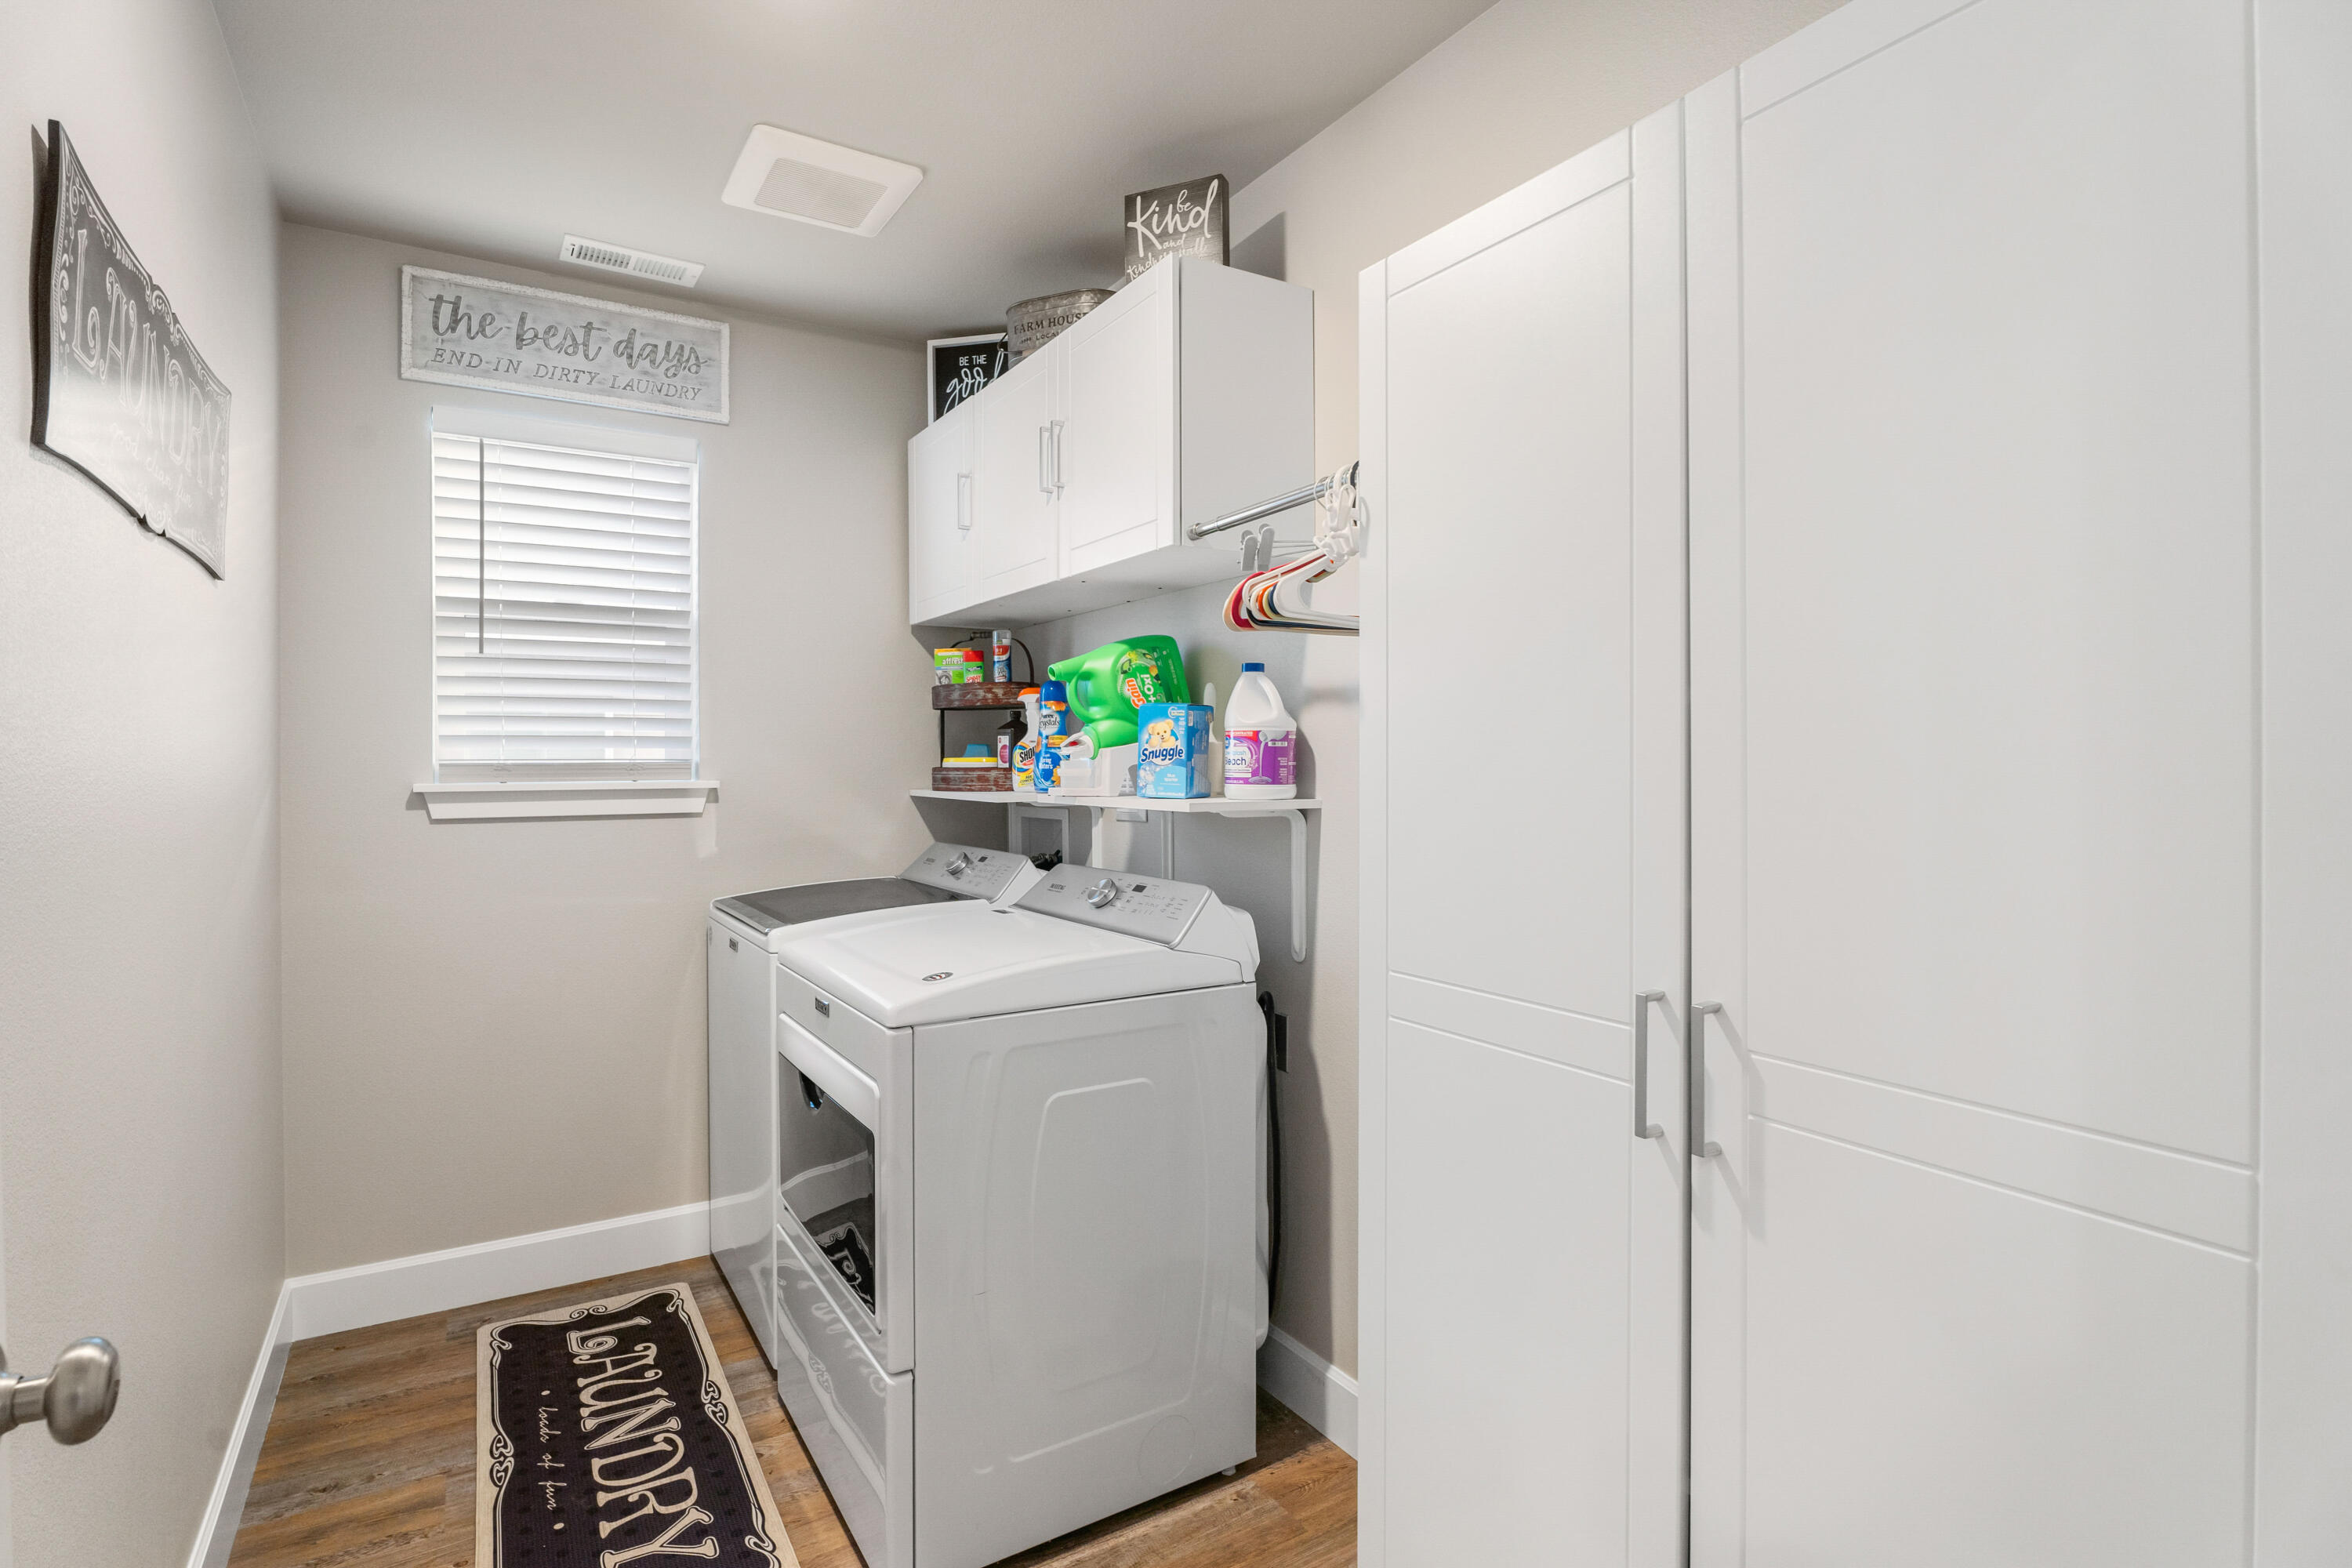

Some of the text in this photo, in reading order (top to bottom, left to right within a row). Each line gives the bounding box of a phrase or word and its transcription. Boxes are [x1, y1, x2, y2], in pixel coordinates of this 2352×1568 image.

[1127, 179, 1219, 258] Kind
[1177, 189, 1193, 212] be
[1163, 233, 1186, 249] and
[429, 294, 708, 379] the best days
[1014, 312, 1089, 335] FARM HOUS
[72, 229, 222, 495] LAUNDRY
[431, 347, 702, 401] END IN DIRTY LAUNDRY
[959, 354, 988, 366] BE THE
[1141, 744, 1185, 763] Snuggle
[536, 1406, 568, 1511] loads of fun
[566, 1316, 720, 1568] LAUNDRY
